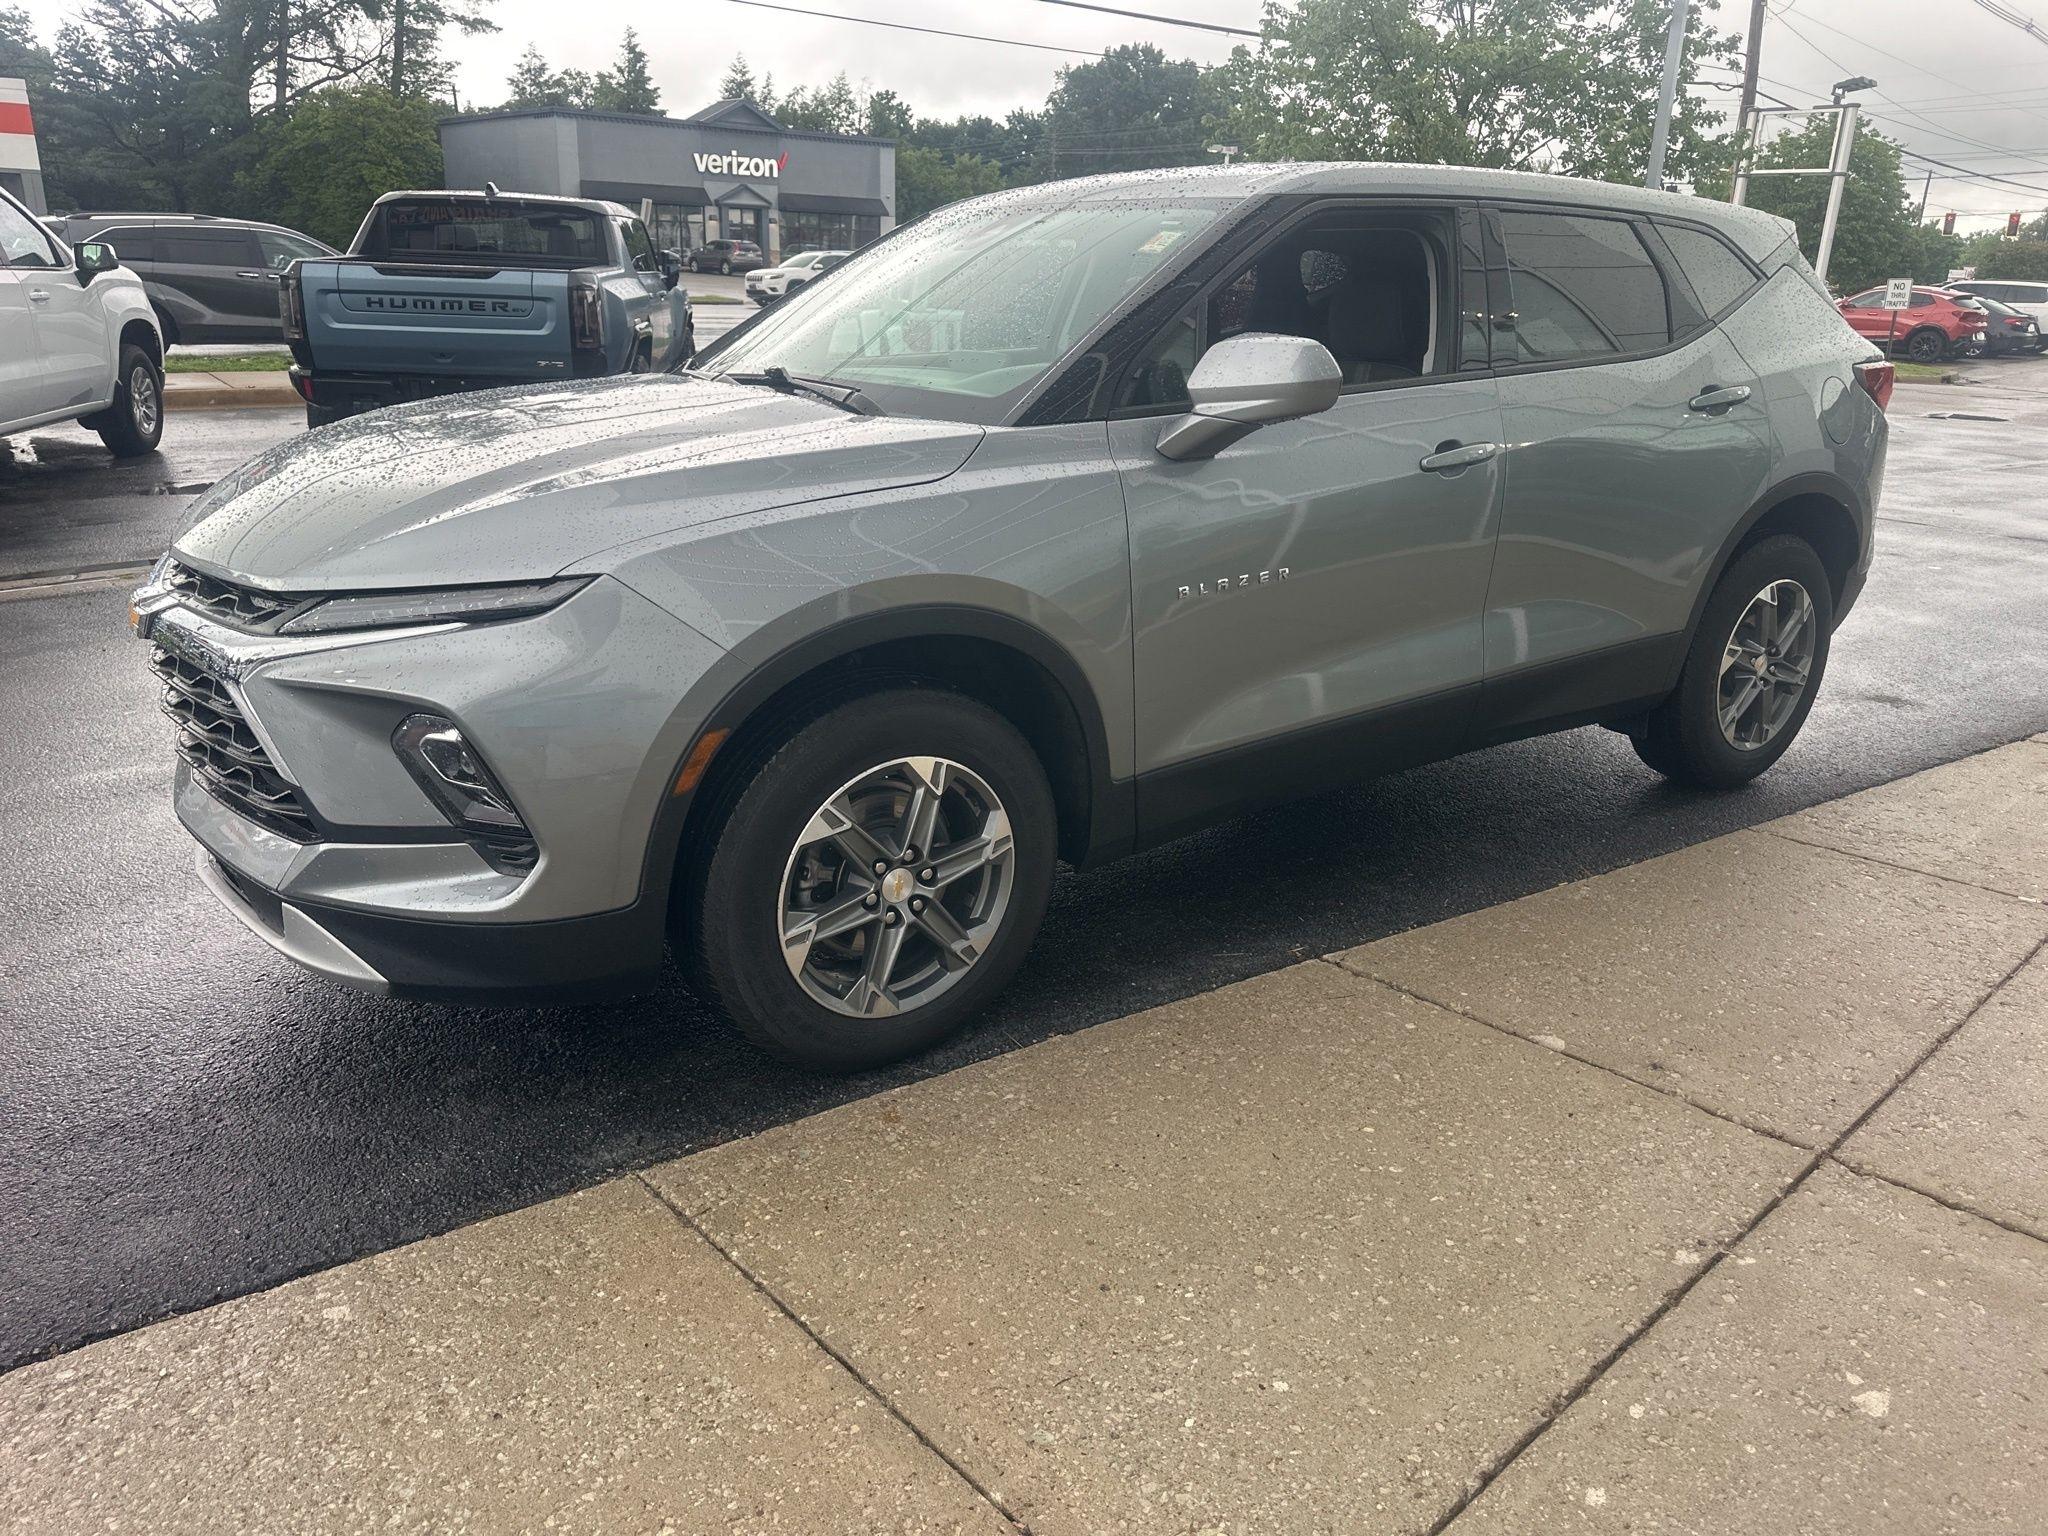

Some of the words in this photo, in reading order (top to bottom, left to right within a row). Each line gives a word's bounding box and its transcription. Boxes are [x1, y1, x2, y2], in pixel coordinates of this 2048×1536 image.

[693, 150, 779, 178] verizon
[1893, 282, 1906, 291] NO
[366, 297, 510, 313] HUMMER
[1178, 567, 1291, 601] BLAZER
